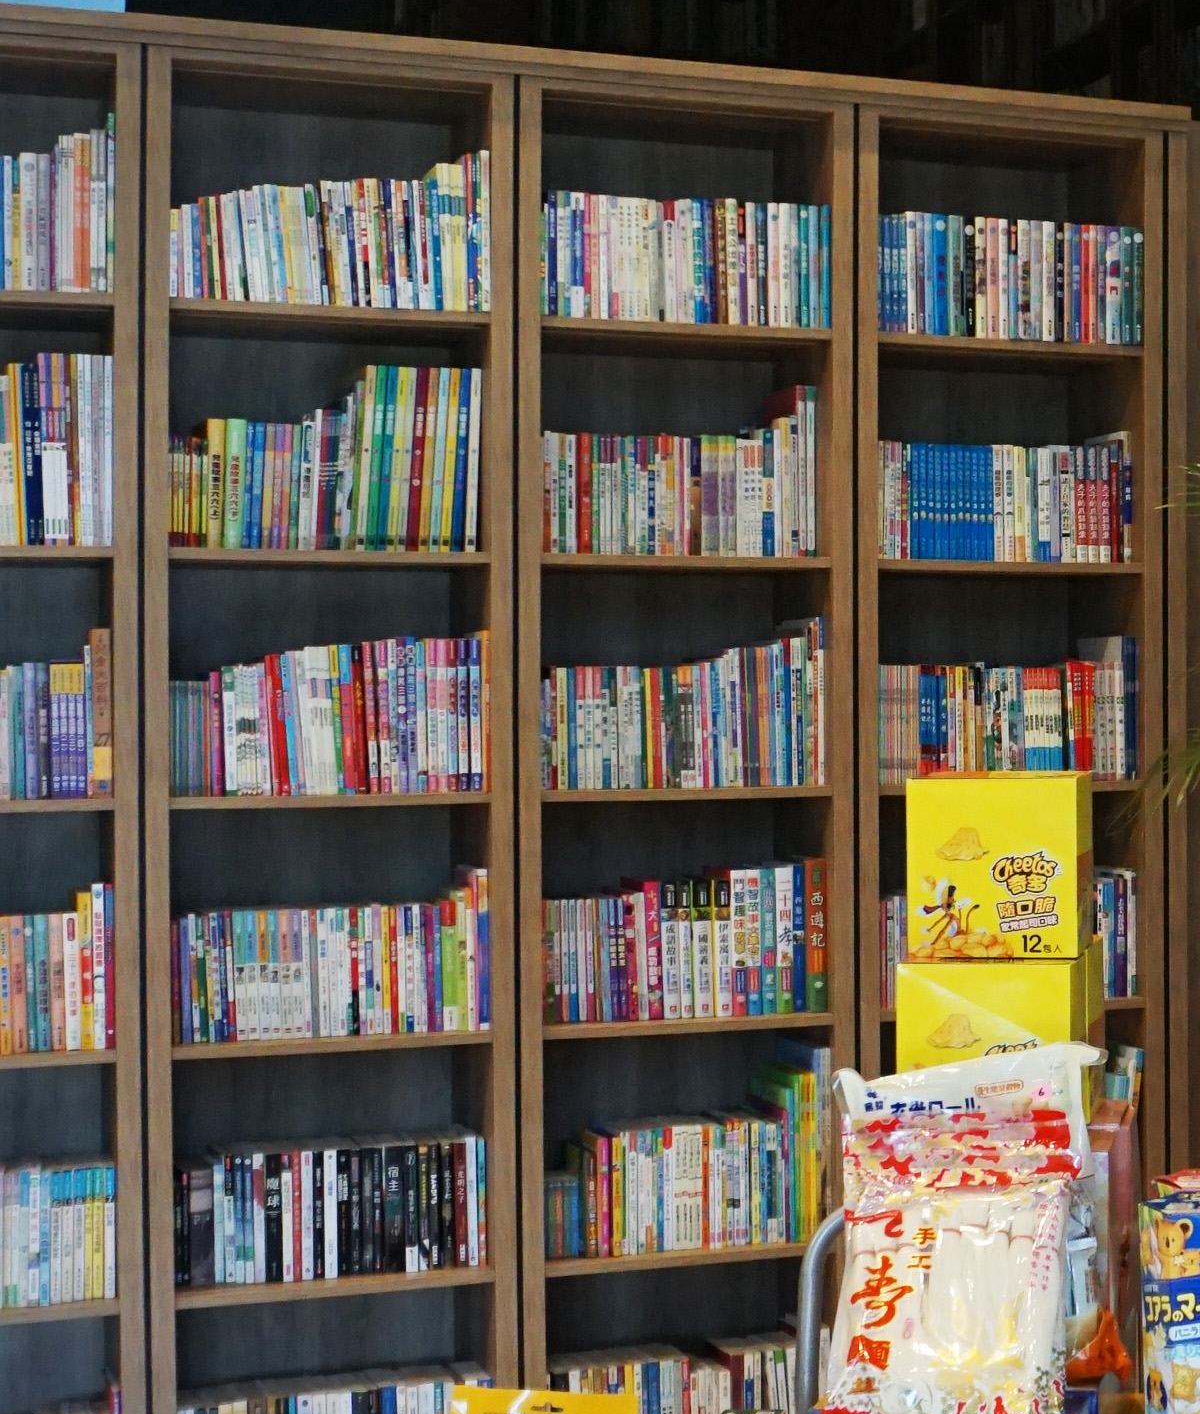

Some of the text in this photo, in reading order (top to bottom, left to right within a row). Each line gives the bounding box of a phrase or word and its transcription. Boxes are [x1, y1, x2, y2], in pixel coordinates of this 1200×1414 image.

[992, 851, 1059, 884] Cheetos
[1008, 873, 1049, 895] 奇多
[778, 879, 793, 948] 二十四孝
[809, 891, 826, 948] 西遊記
[996, 896, 1057, 919] 隨口脆
[387, 1165, 400, 1193] 宿主
[906, 1224, 938, 1272] 手工
